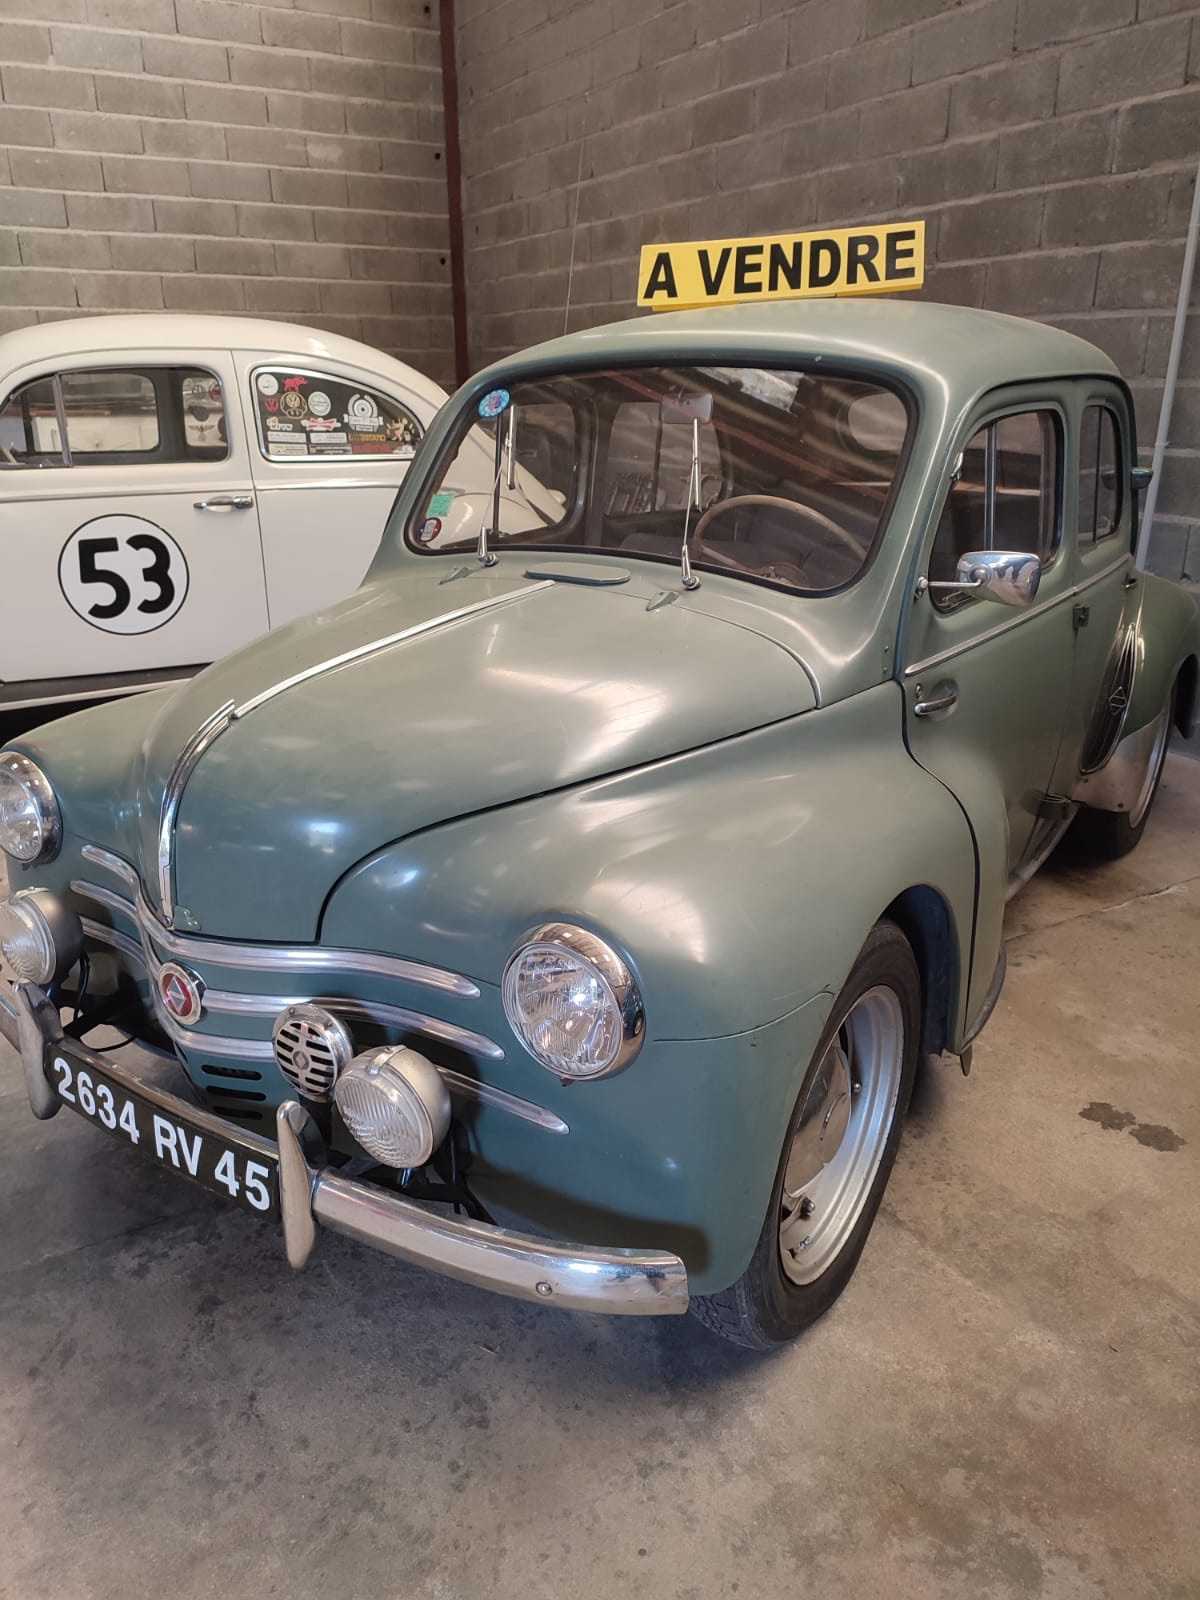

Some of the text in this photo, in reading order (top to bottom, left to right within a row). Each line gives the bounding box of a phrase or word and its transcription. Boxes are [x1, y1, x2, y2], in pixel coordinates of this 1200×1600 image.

[643, 230, 916, 299] A VENDRE
[78, 533, 176, 619] 53
[53, 1057, 271, 1212] 2634 RV 45
